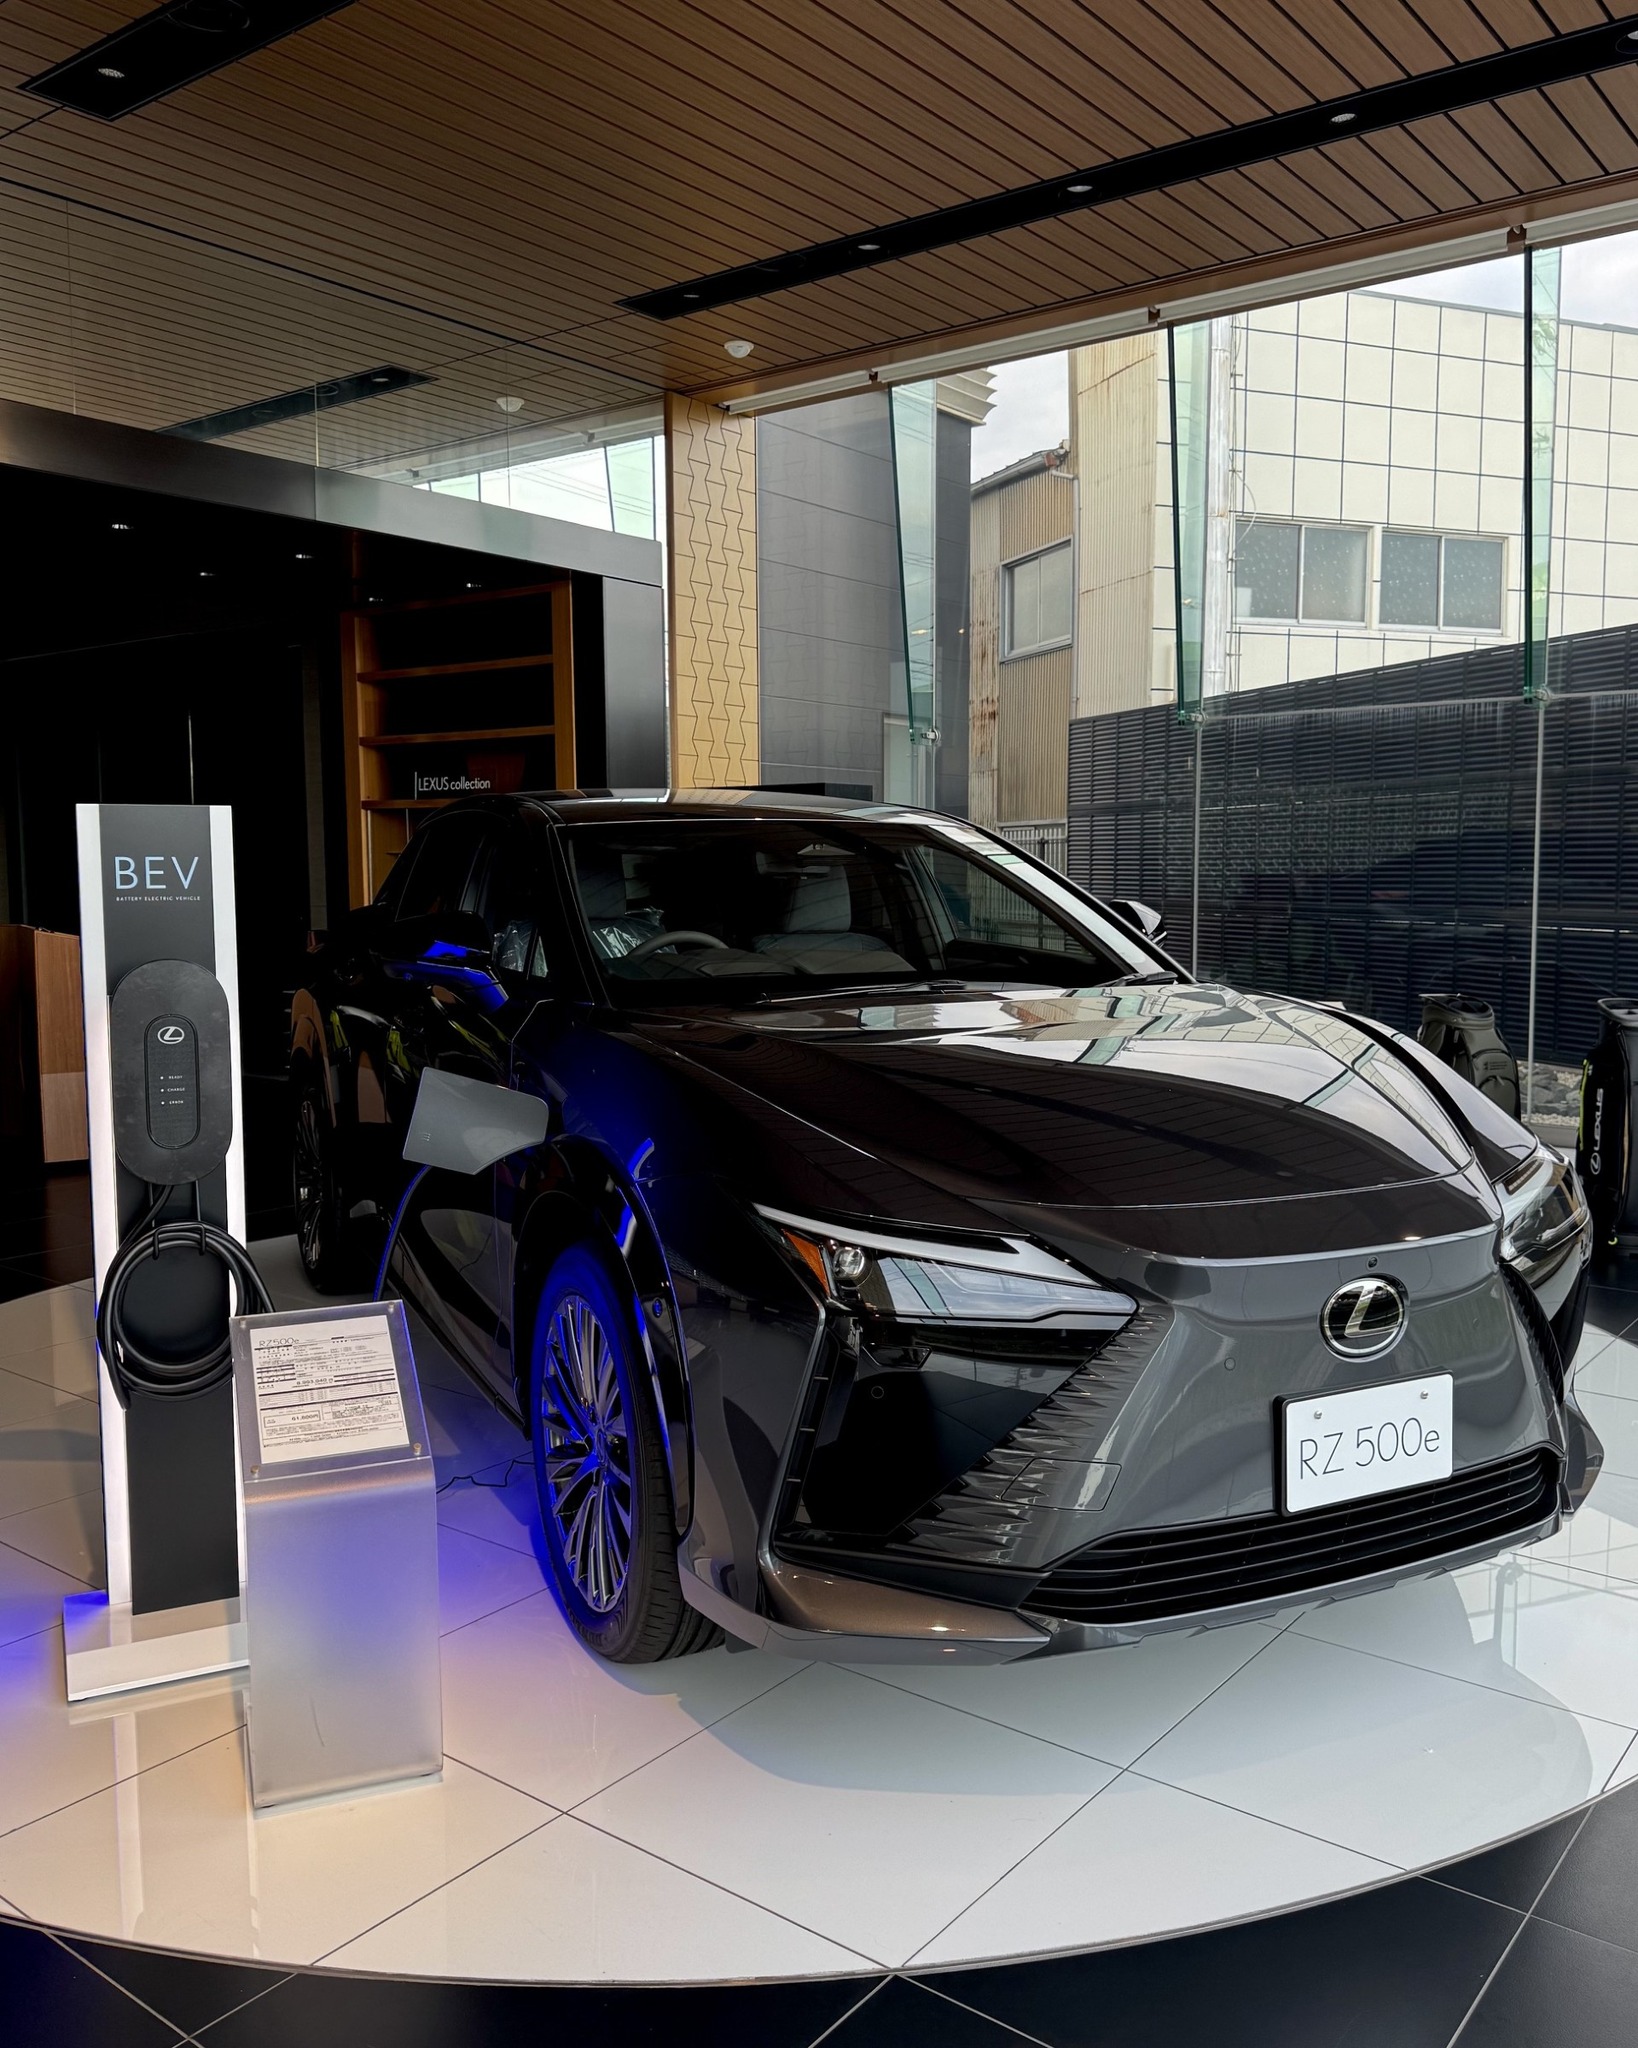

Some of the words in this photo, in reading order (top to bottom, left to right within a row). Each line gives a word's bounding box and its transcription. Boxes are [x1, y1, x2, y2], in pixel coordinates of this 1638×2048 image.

[418, 776, 449, 791] LEXUS
[450, 776, 491, 790] collection
[114, 856, 199, 890] BEV
[1593, 1088, 1604, 1151] LEXUS
[1300, 1432, 1345, 1480] RZ
[1355, 1417, 1440, 1467] 500e
